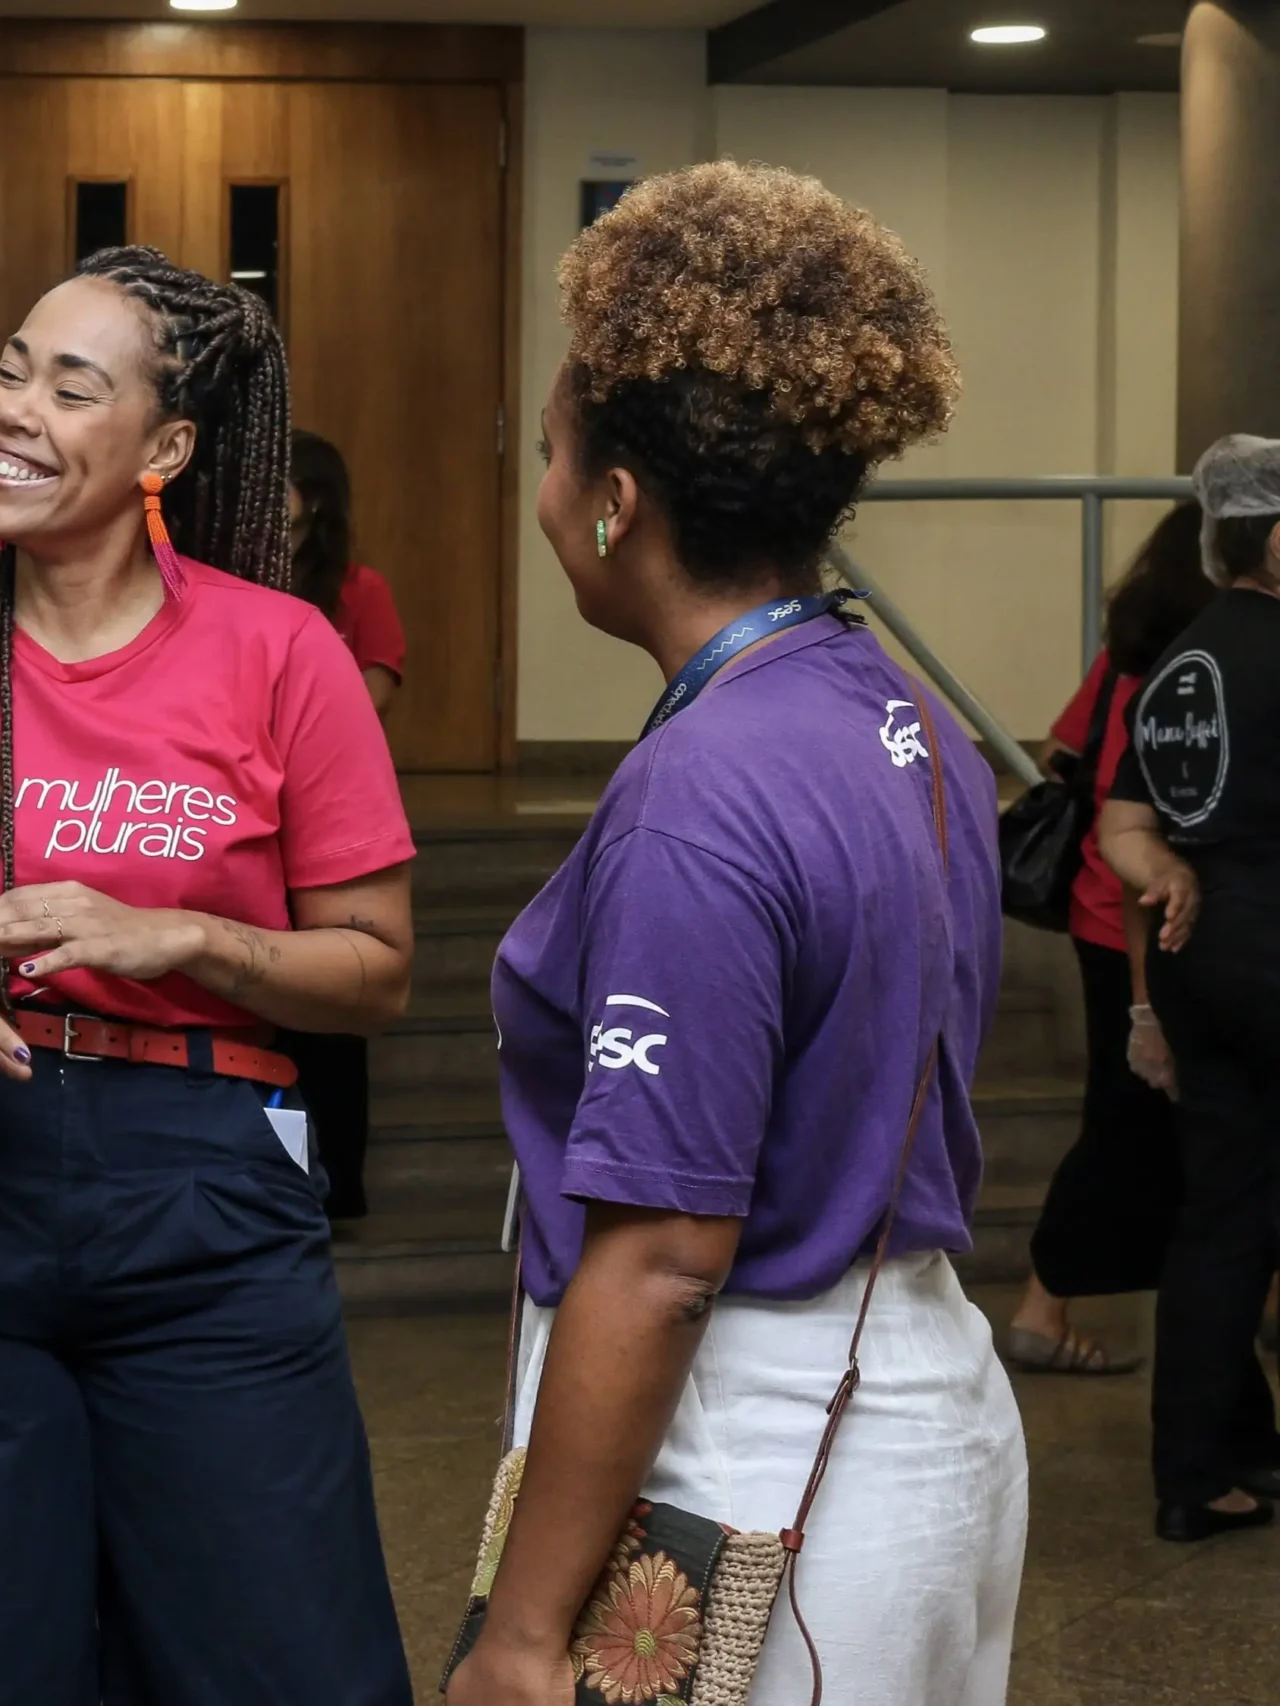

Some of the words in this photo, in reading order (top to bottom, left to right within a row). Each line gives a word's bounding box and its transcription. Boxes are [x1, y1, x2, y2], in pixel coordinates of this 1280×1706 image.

[768, 600, 802, 621] sesc
[14, 767, 237, 826] mulheres
[45, 815, 208, 861] plurais
